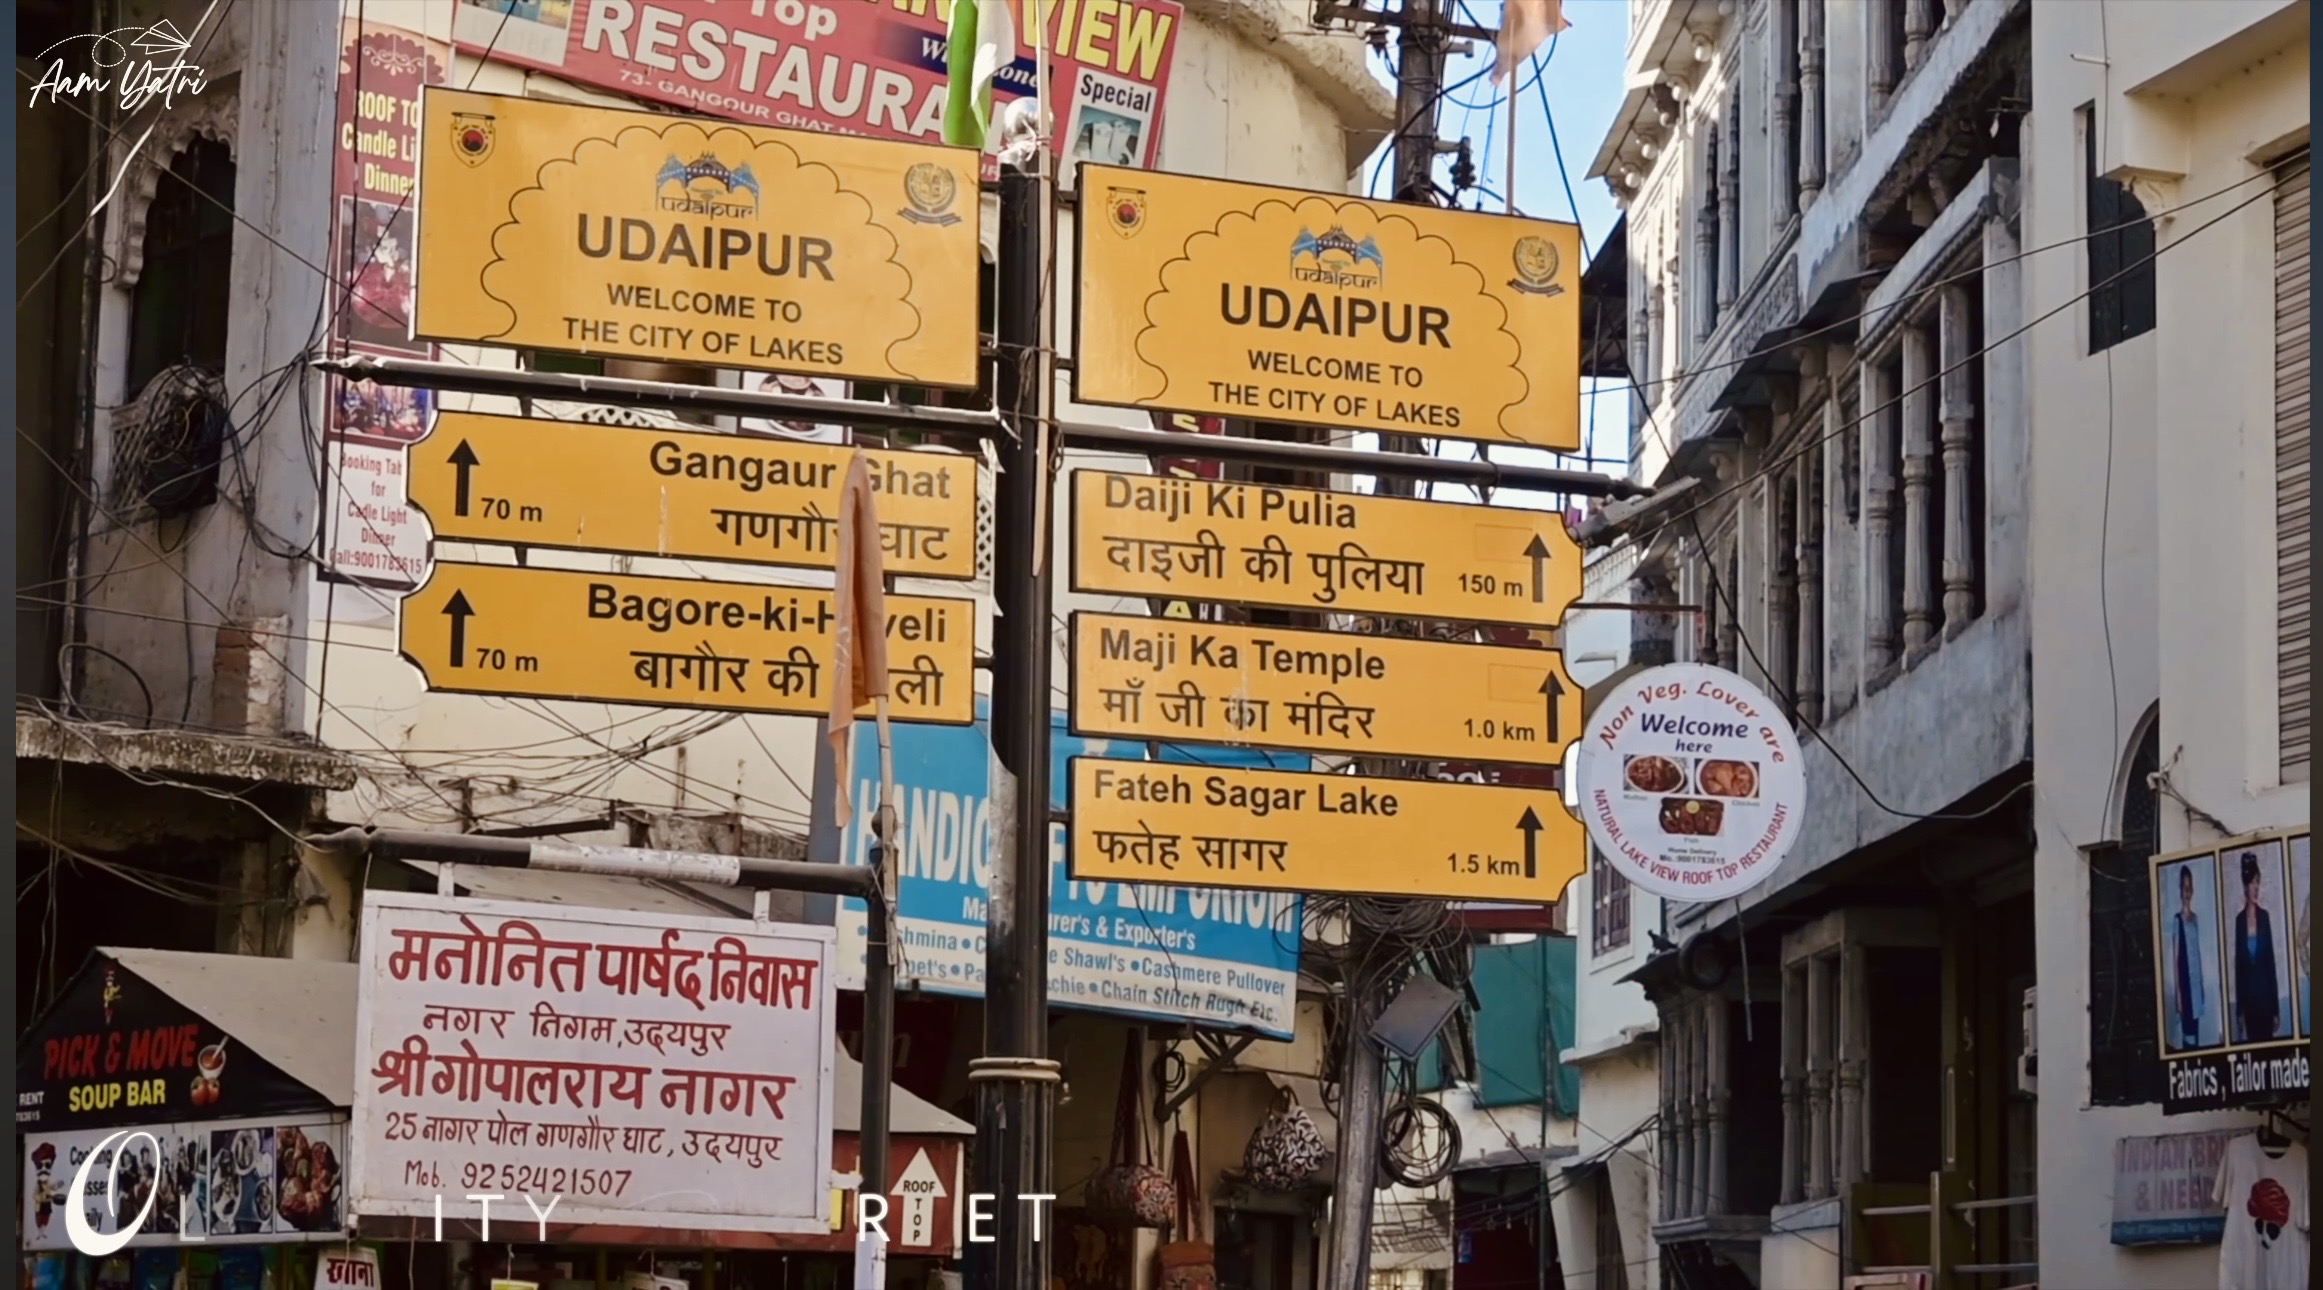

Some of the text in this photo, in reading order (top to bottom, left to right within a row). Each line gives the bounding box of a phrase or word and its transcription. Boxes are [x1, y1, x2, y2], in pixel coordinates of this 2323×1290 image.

[582, 0, 1006, 157] RESTAURA
[1080, 74, 1152, 113] Special
[401, 99, 418, 129] TO
[657, 79, 769, 119] GANGOUR
[342, 122, 416, 162] Candle Li
[661, 190, 753, 221] udaipur
[577, 213, 834, 282] UDAIPUR
[1295, 262, 1377, 291] udaipur
[607, 283, 801, 323] WELCOME TO
[1221, 283, 1451, 348] UDAIPUR
[563, 317, 843, 366] THE CITY OF LAKES
[1248, 350, 1422, 389] WELCOME TO
[1208, 381, 1460, 428] THE CITY OF LAKES
[386, 458, 402, 476] Tab
[650, 440, 837, 493] Gangaur
[371, 481, 386, 497] for
[1105, 475, 1356, 529] Daiji Ki Pulia
[381, 505, 407, 528] Light
[481, 497, 543, 522] 70 m
[711, 501, 838, 554] गणगौ
[361, 527, 395, 546] Dinner
[1102, 529, 1425, 603] दाइजी की पुलिया
[1458, 573, 1523, 598] 150 m
[588, 583, 946, 643] Bagore-ki-Hveli
[476, 648, 539, 672] 70 m
[630, 640, 819, 699] बागौर की
[1100, 627, 1386, 684] Maji Ka Temple
[1099, 677, 1376, 739] माँ जी का मंदिर
[1600, 681, 1785, 764] Non Veg. Lover are
[1641, 713, 1749, 738] Welcome
[1464, 718, 1536, 742] 1.0 km
[1675, 739, 1712, 754] here
[1093, 769, 1399, 817] Fateh Sagar Lake
[1093, 819, 1289, 873] फतेह सागर
[1593, 789, 1788, 885] NATURAL LAKE VIEW ROOF TOP RESTAURANT
[1447, 853, 1520, 877] 1.5 km
[899, 926, 957, 951] hmina
[1096, 915, 1109, 938] &
[1114, 917, 1196, 950] Exporter's
[389, 913, 819, 1011] मनोनित पार्षद निवास
[1064, 946, 1125, 973] Shawl's
[1142, 957, 1222, 985] Cashmere
[1227, 969, 1286, 997] Pullover
[1102, 980, 1147, 1002] Chain
[1152, 986, 1201, 1010] Stitch
[423, 1004, 515, 1039] नगर
[43, 1023, 200, 1081] PICK & MOVE
[2227, 1051, 2268, 1095] Tailor
[2271, 1049, 2310, 1090] made
[19, 1091, 45, 1106] RENT
[69, 1078, 167, 1112] SOUP BAR
[660, 1068, 796, 1120] नागर
[385, 1111, 417, 1140] 25
[422, 1115, 483, 1146] नागर
[487, 1108, 532, 1146] पोल
[536, 1114, 620, 1152] गणगौर
[2119, 1138, 2187, 1173] INDIAN
[404, 1160, 632, 1197] Mob. 9252421507
[903, 1180, 936, 1194] ROOF
[911, 1198, 923, 1242] TOP
